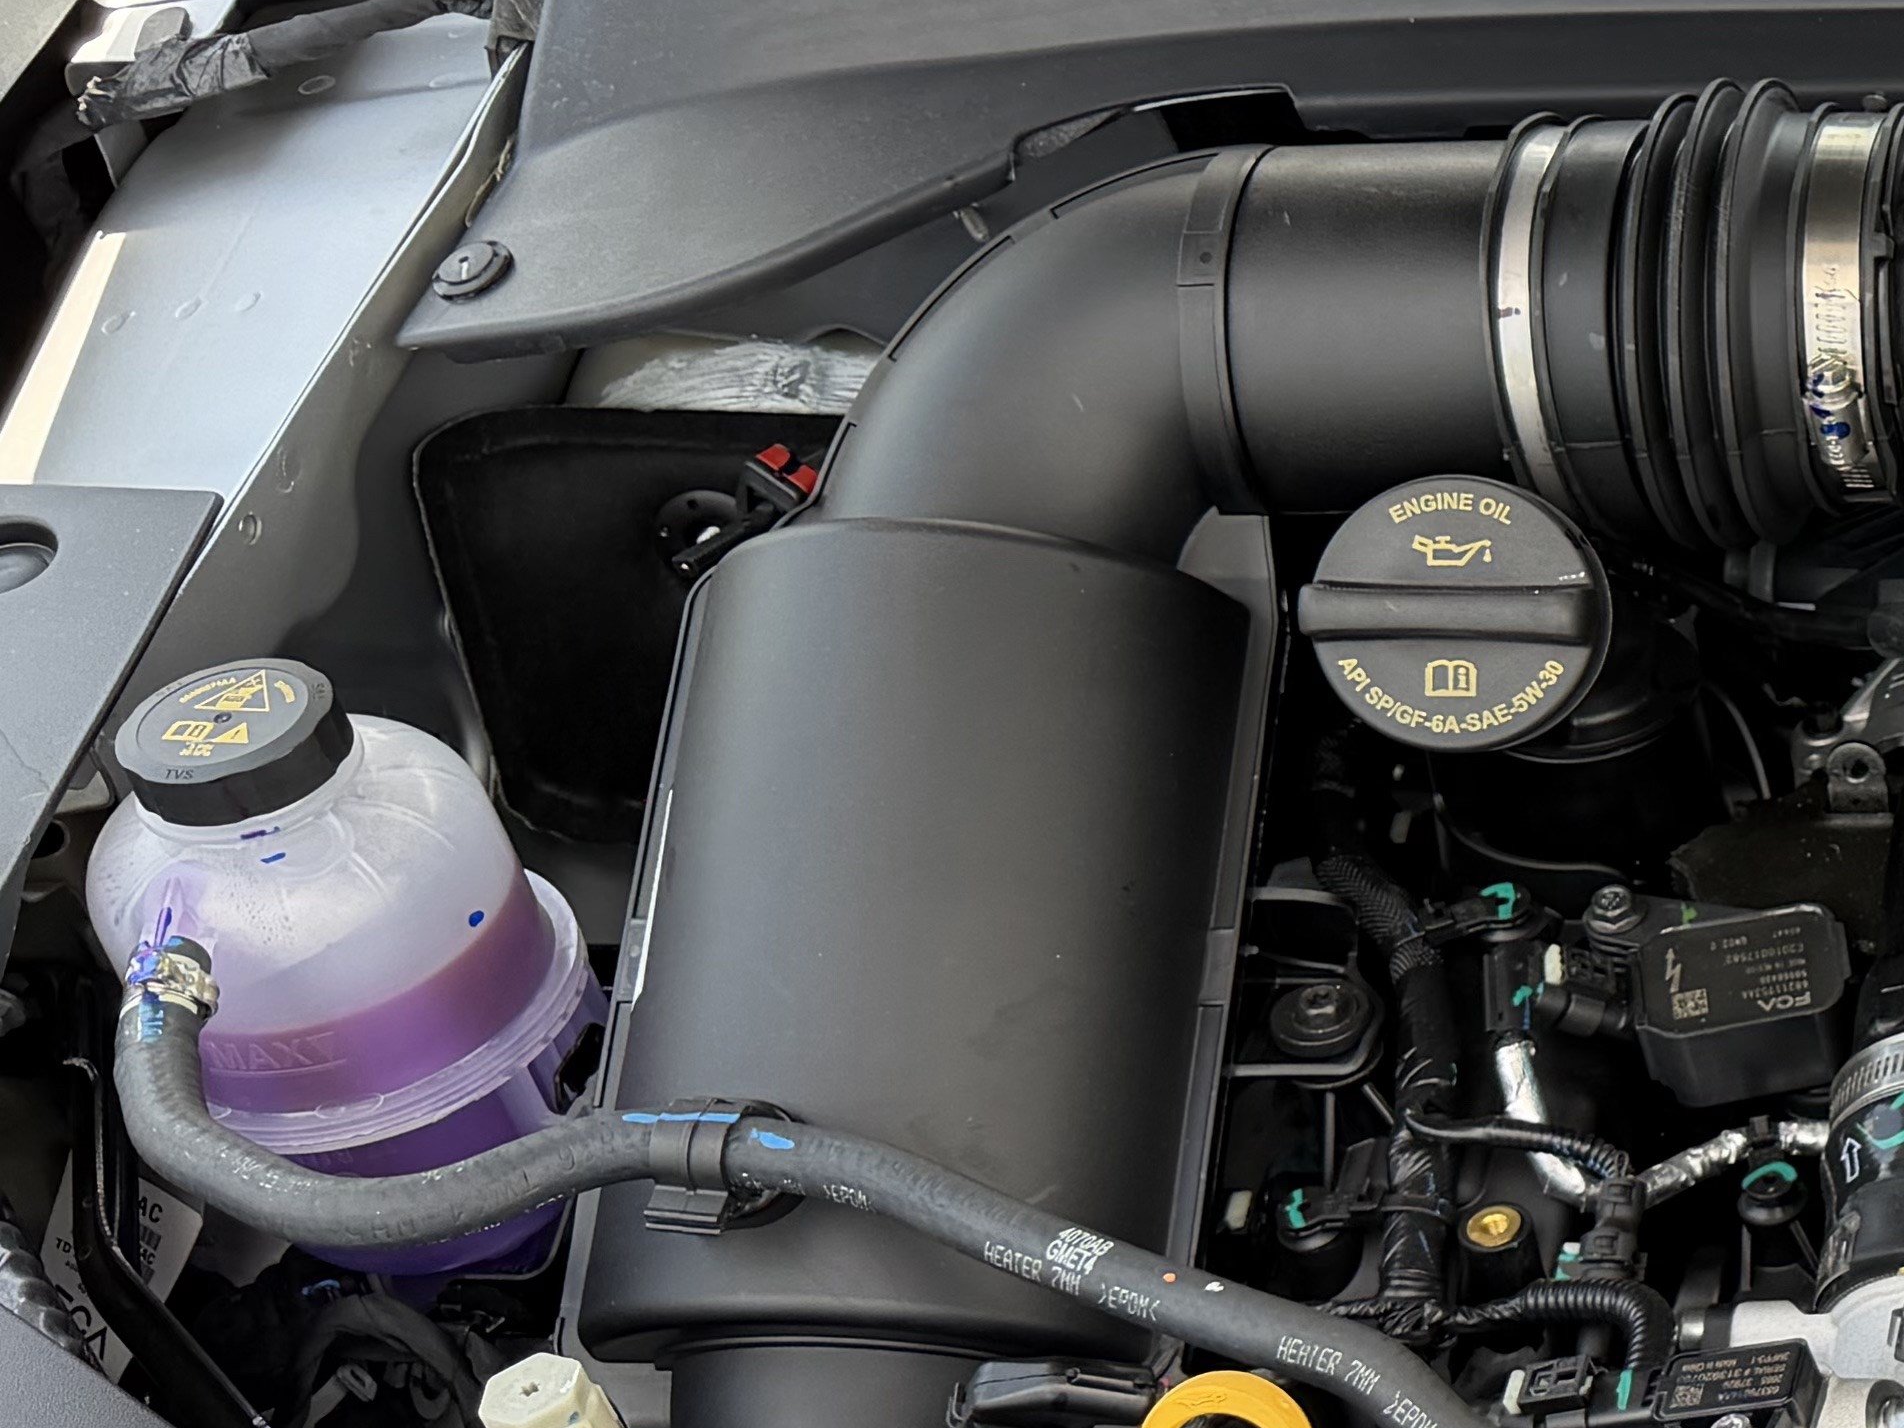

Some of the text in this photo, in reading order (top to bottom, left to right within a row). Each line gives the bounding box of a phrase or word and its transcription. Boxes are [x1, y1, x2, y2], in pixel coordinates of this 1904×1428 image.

[1388, 492, 1511, 525] ENGINE OIL
[1337, 658, 1370, 692] API
[164, 768, 194, 780] TVS
[1757, 993, 1812, 1012] FCA
[983, 1241, 1043, 1282] HEATER
[1277, 1337, 1343, 1374] HEATER
[1350, 1360, 1380, 1396] 7MM
